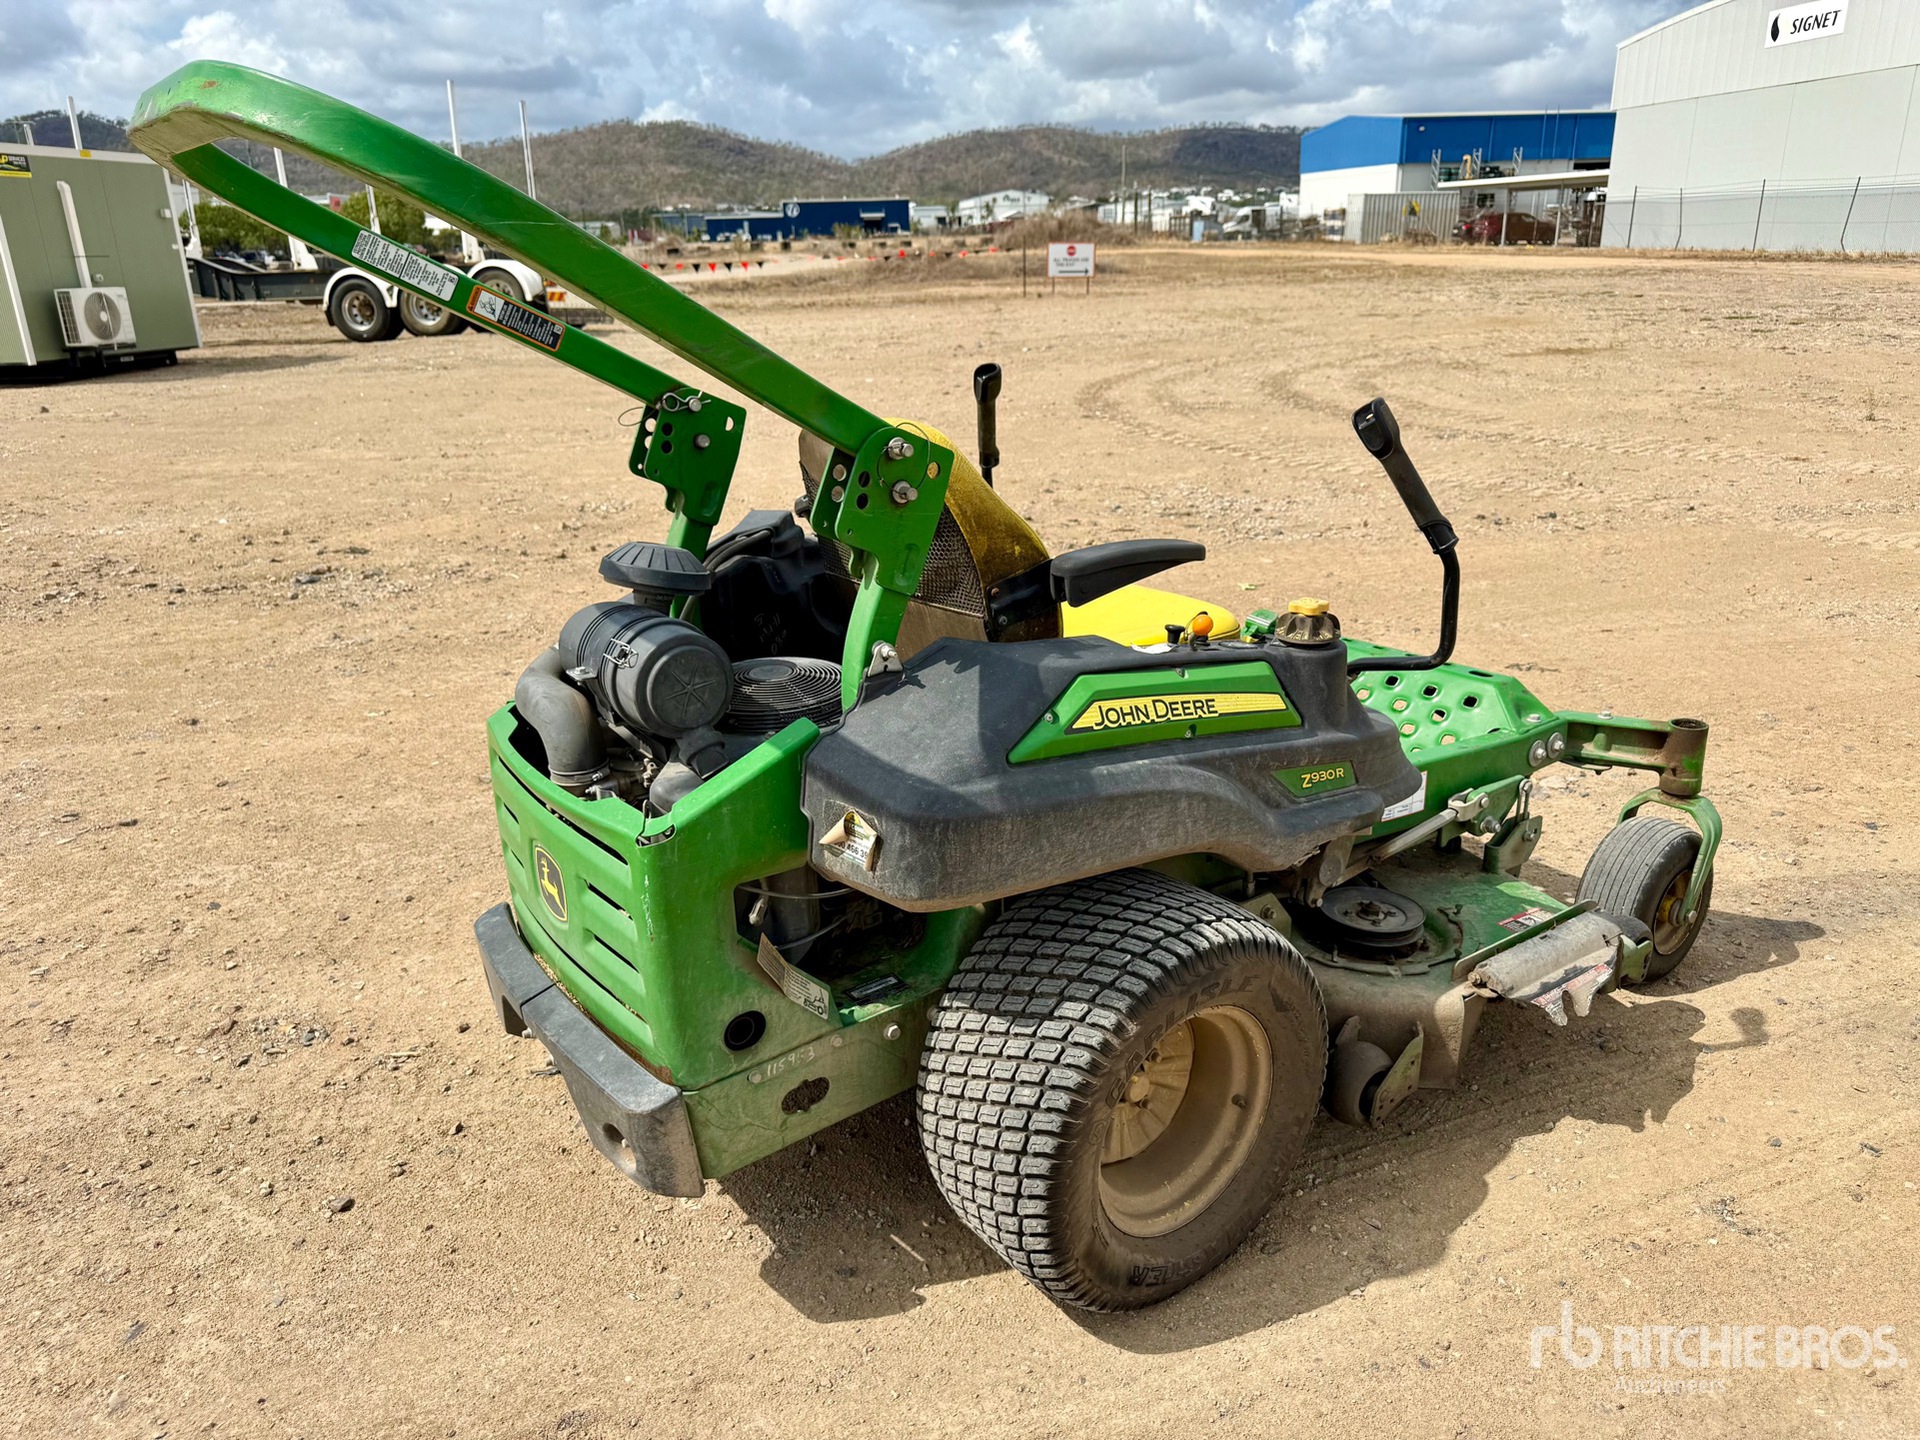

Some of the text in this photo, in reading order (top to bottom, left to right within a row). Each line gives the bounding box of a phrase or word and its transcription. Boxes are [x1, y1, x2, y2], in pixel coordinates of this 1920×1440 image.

[1790, 9, 1843, 35] SIGNET
[1094, 698, 1219, 727] JOHN DEERE
[1301, 767, 1345, 789] Z930R
